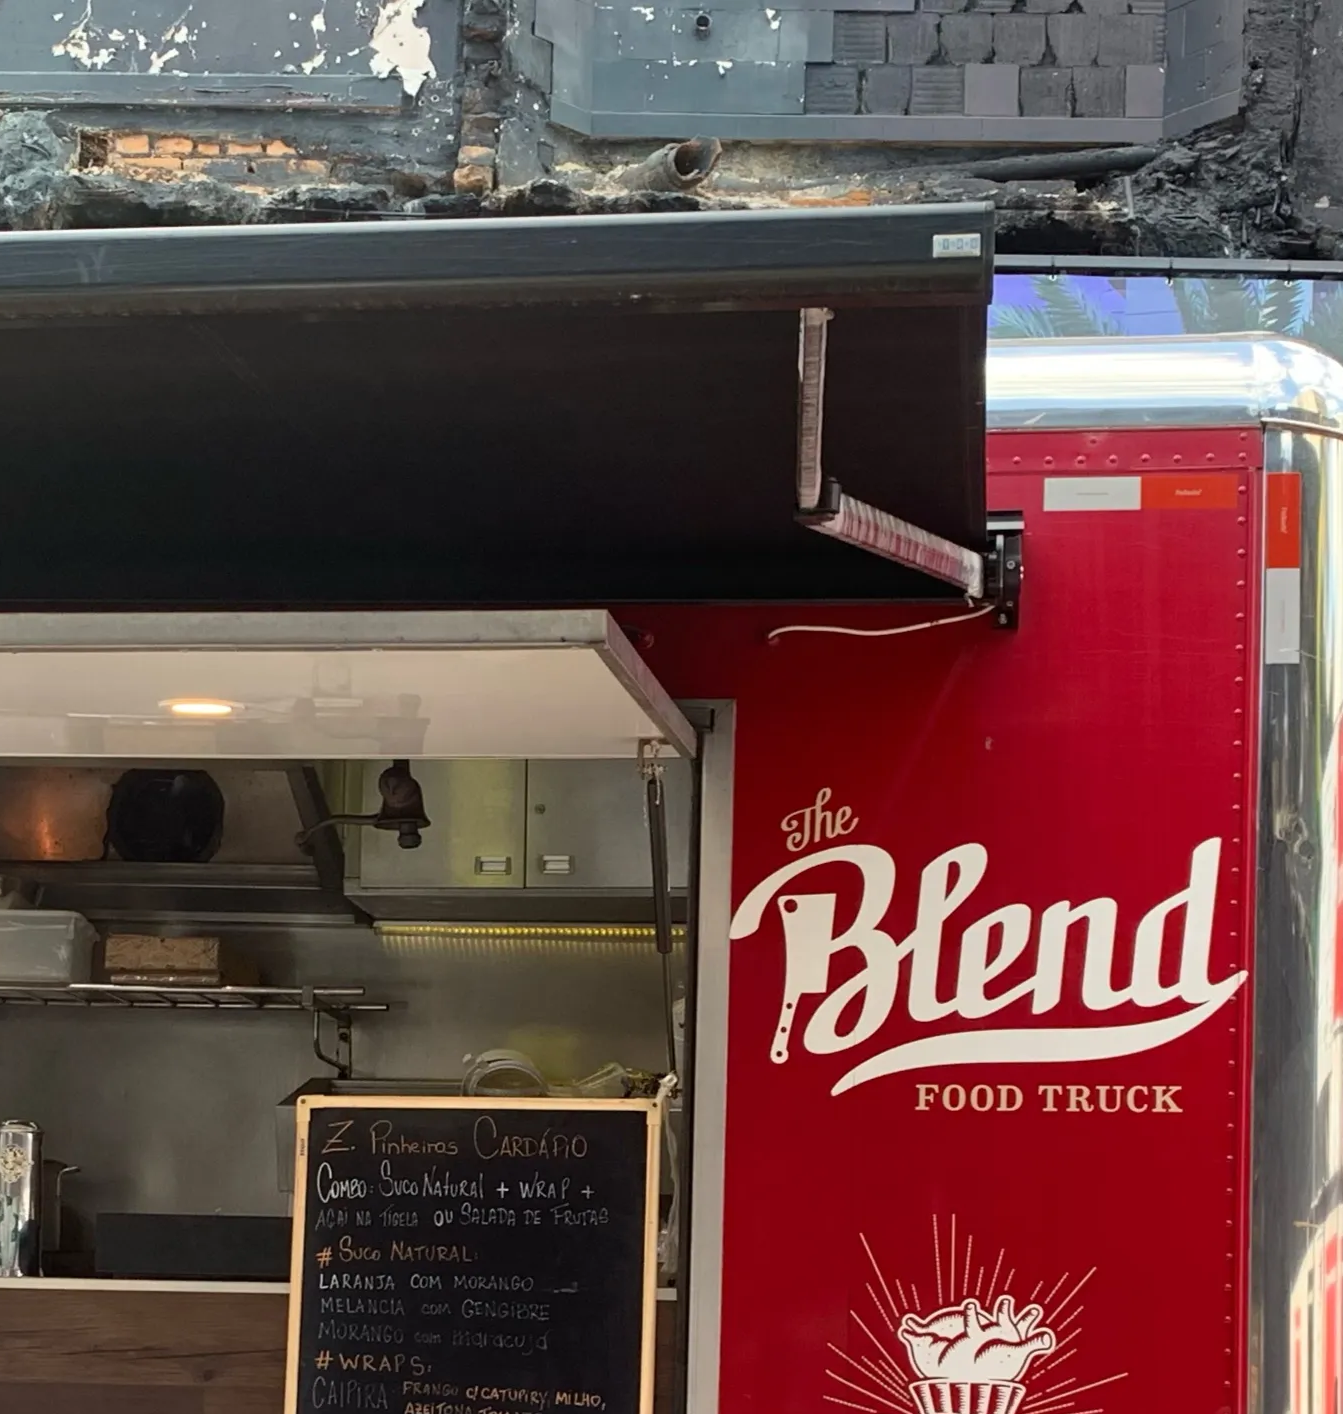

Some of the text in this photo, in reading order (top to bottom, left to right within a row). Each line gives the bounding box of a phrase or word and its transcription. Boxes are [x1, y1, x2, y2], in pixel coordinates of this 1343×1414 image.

[780, 787, 859, 852] The
[729, 836, 1249, 1096] Blend
[915, 1084, 1184, 1113] FOOD TRUCK
[370, 1119, 459, 1155] Pinheiros
[519, 1171, 571, 1199] WRAP
[523, 1209, 542, 1225] DE
[319, 1273, 395, 1290] LARANJA
[454, 1275, 534, 1292] MORANGO
[321, 1296, 405, 1316] MELANCIA
